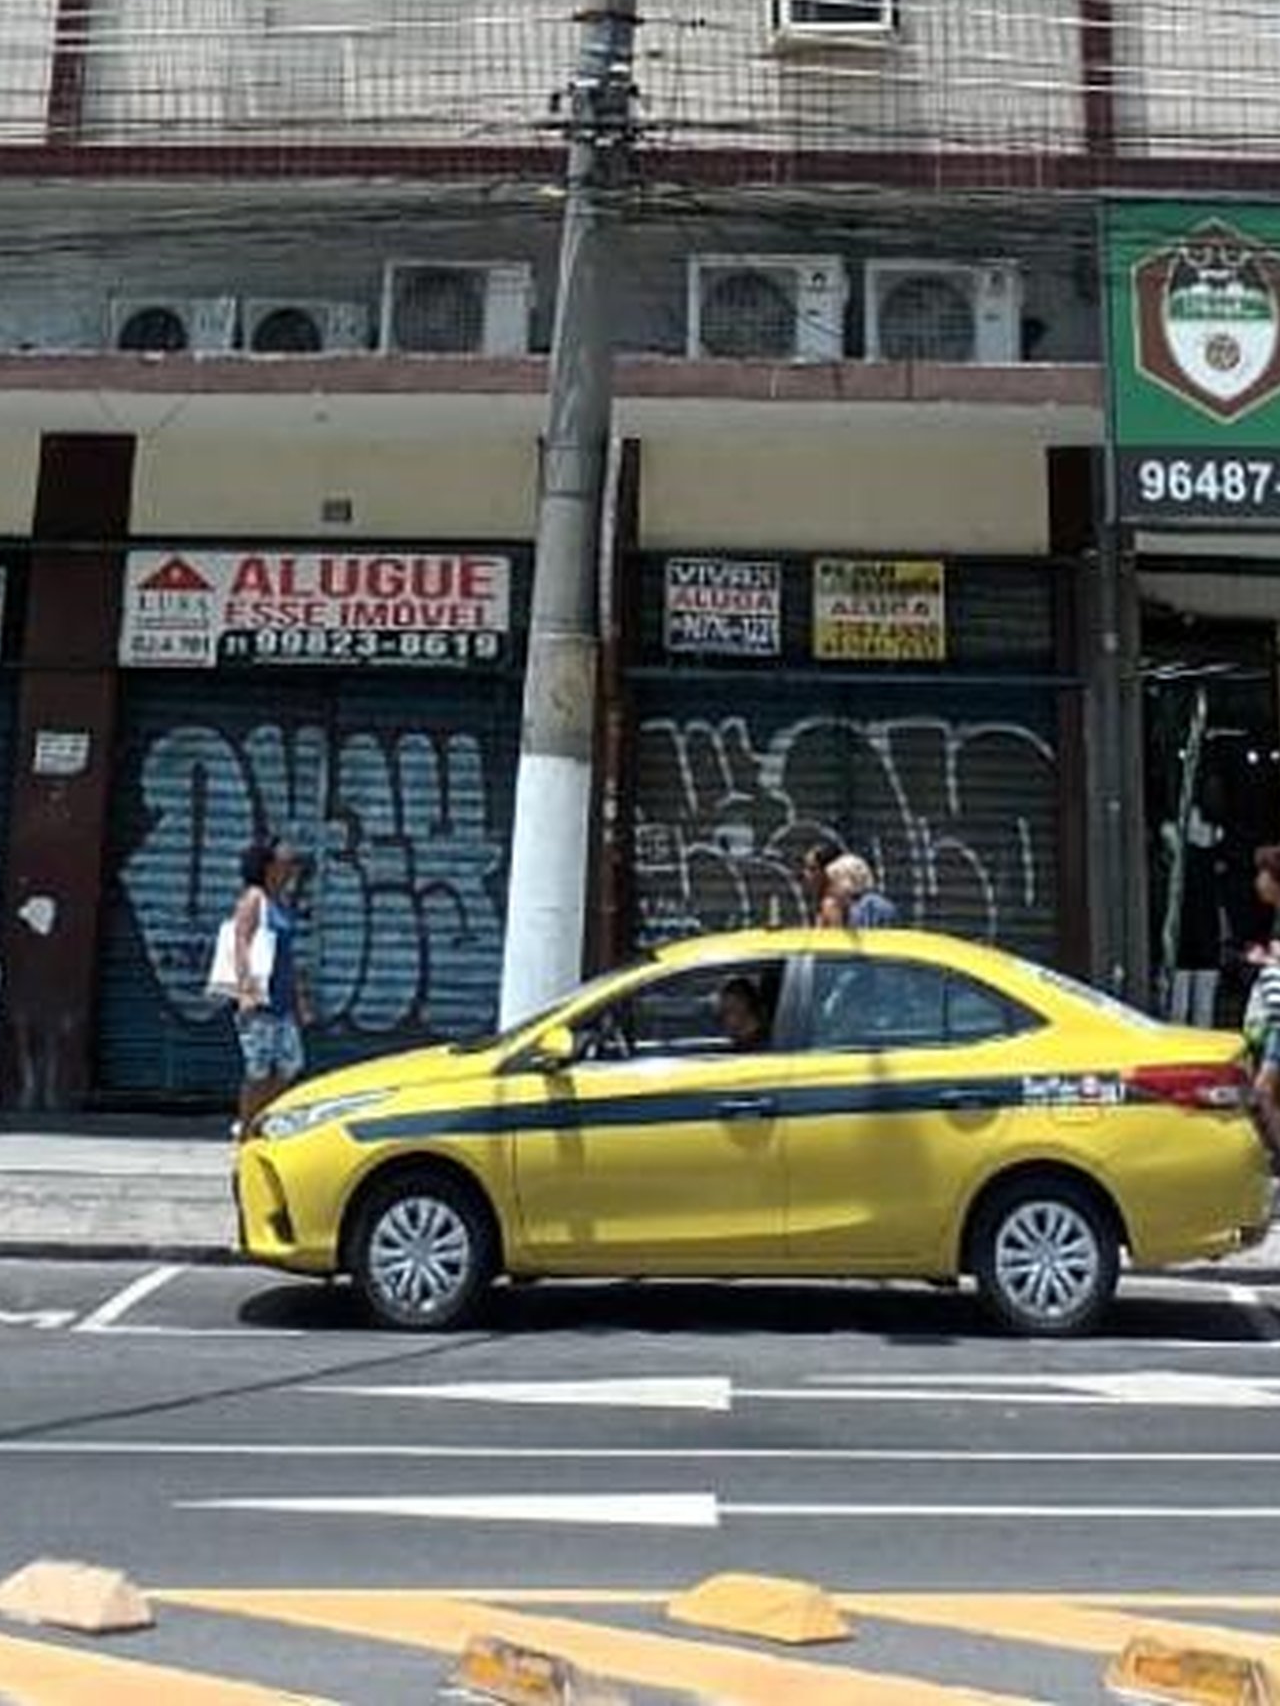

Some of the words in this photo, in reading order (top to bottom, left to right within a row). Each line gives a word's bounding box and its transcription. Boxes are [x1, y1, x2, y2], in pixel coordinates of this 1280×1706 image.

[230, 557, 497, 601] ALUGUE
[672, 588, 775, 610] ALUGA
[225, 602, 327, 626] ESSE
